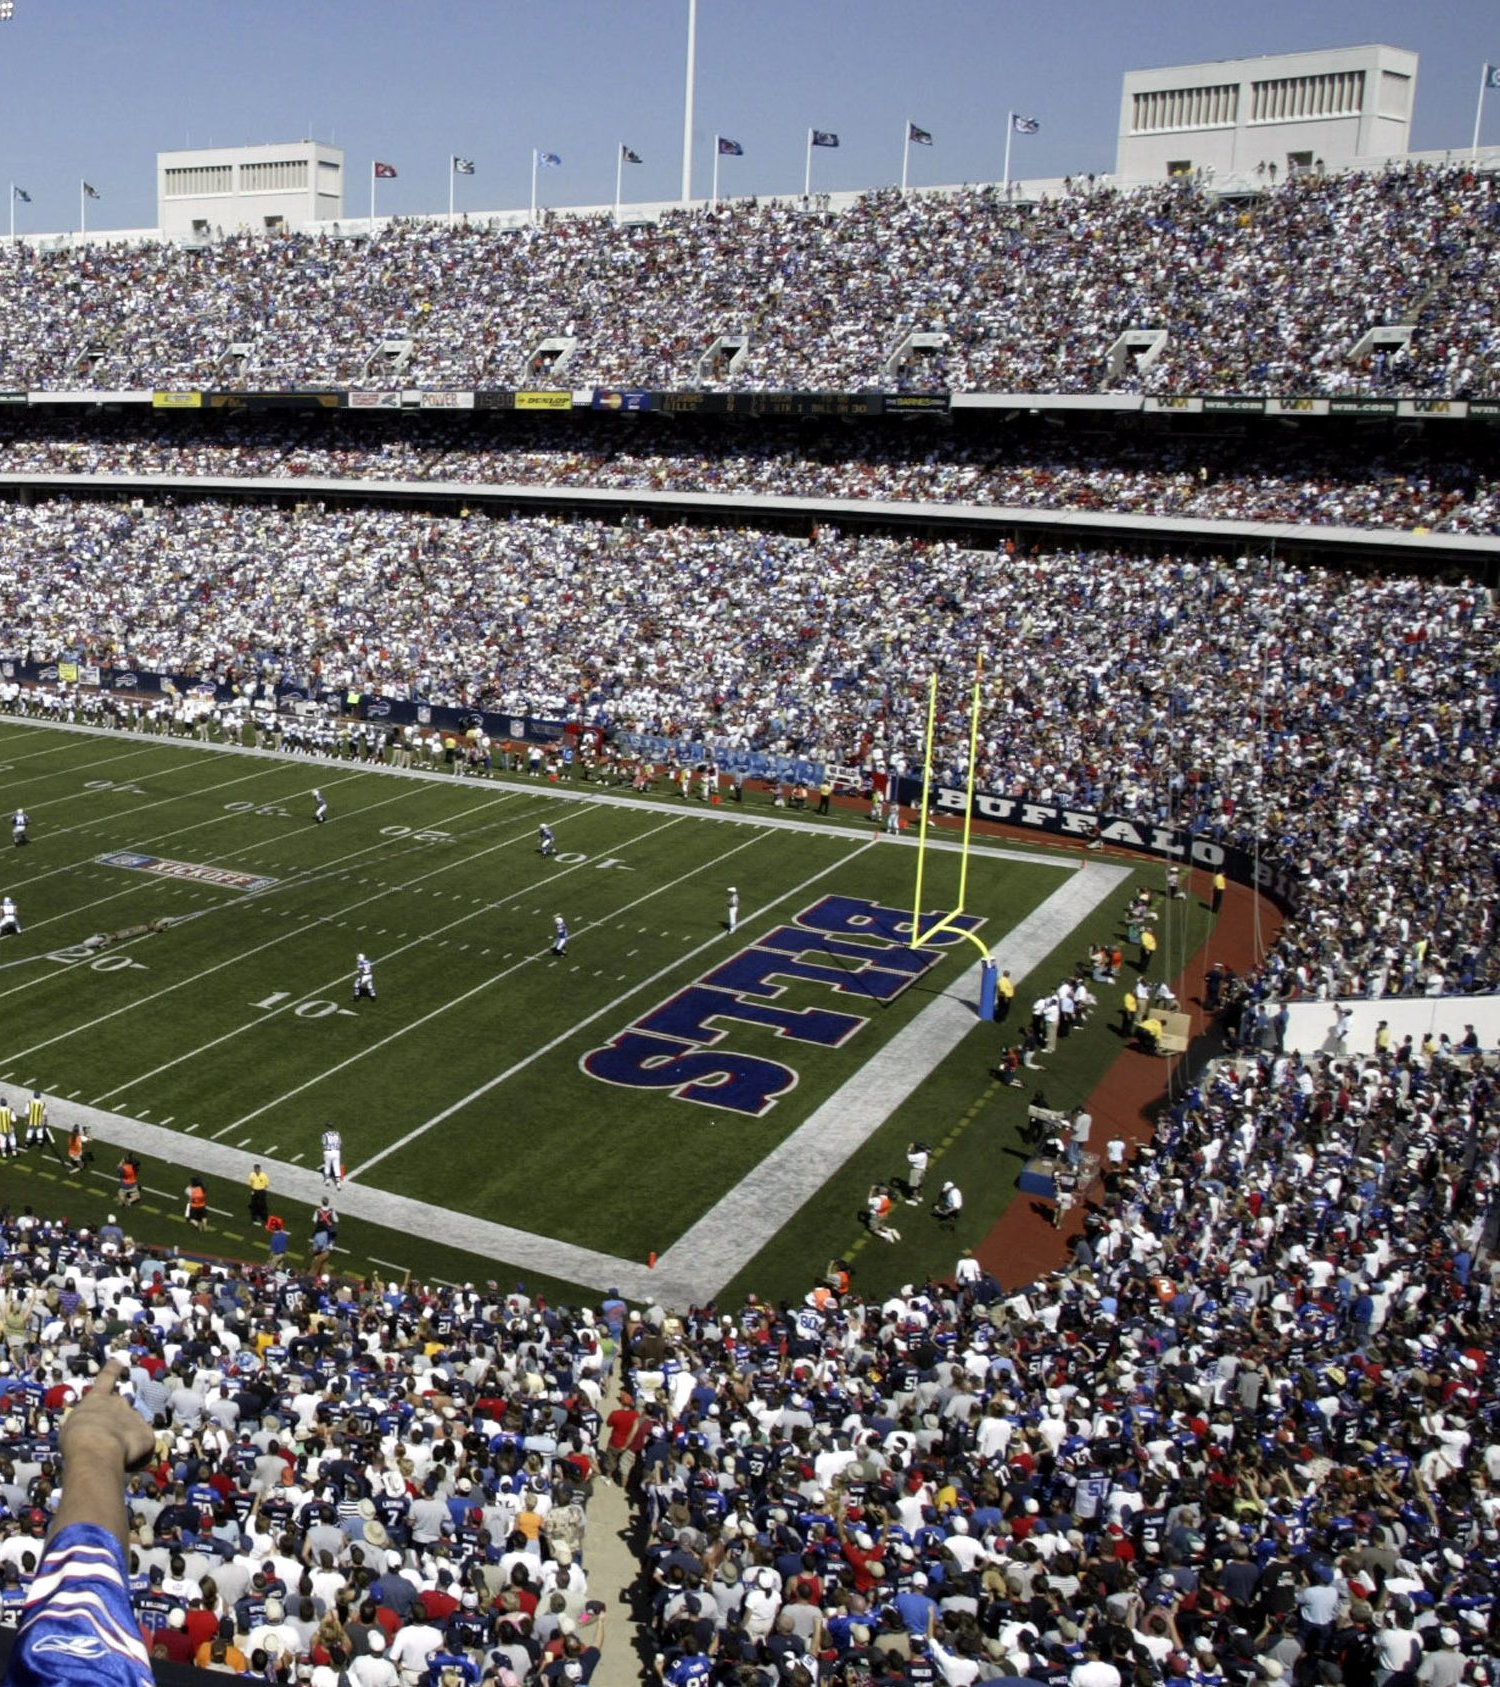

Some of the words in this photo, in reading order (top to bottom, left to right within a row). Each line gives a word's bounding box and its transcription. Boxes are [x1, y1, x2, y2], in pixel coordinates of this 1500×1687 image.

[422, 393, 458, 407] POWER
[526, 396, 570, 405] DUNLOP
[1157, 397, 1189, 407] WM
[1204, 401, 1263, 409] wm.com
[1280, 399, 1314, 410] WM
[1413, 402, 1451, 412] WM
[1331, 403, 1395, 412] wm.com
[937, 787, 1225, 866] BUFFALO
[46, 946, 133, 972] 20
[248, 991, 339, 1018] 10
[579, 894, 989, 1117] BILLS
[1158, 1279, 1171, 1293] 2
[438, 1321, 451, 1335] 21
[237, 1508, 249, 1522] 7
[388, 1510, 399, 1526] 7
